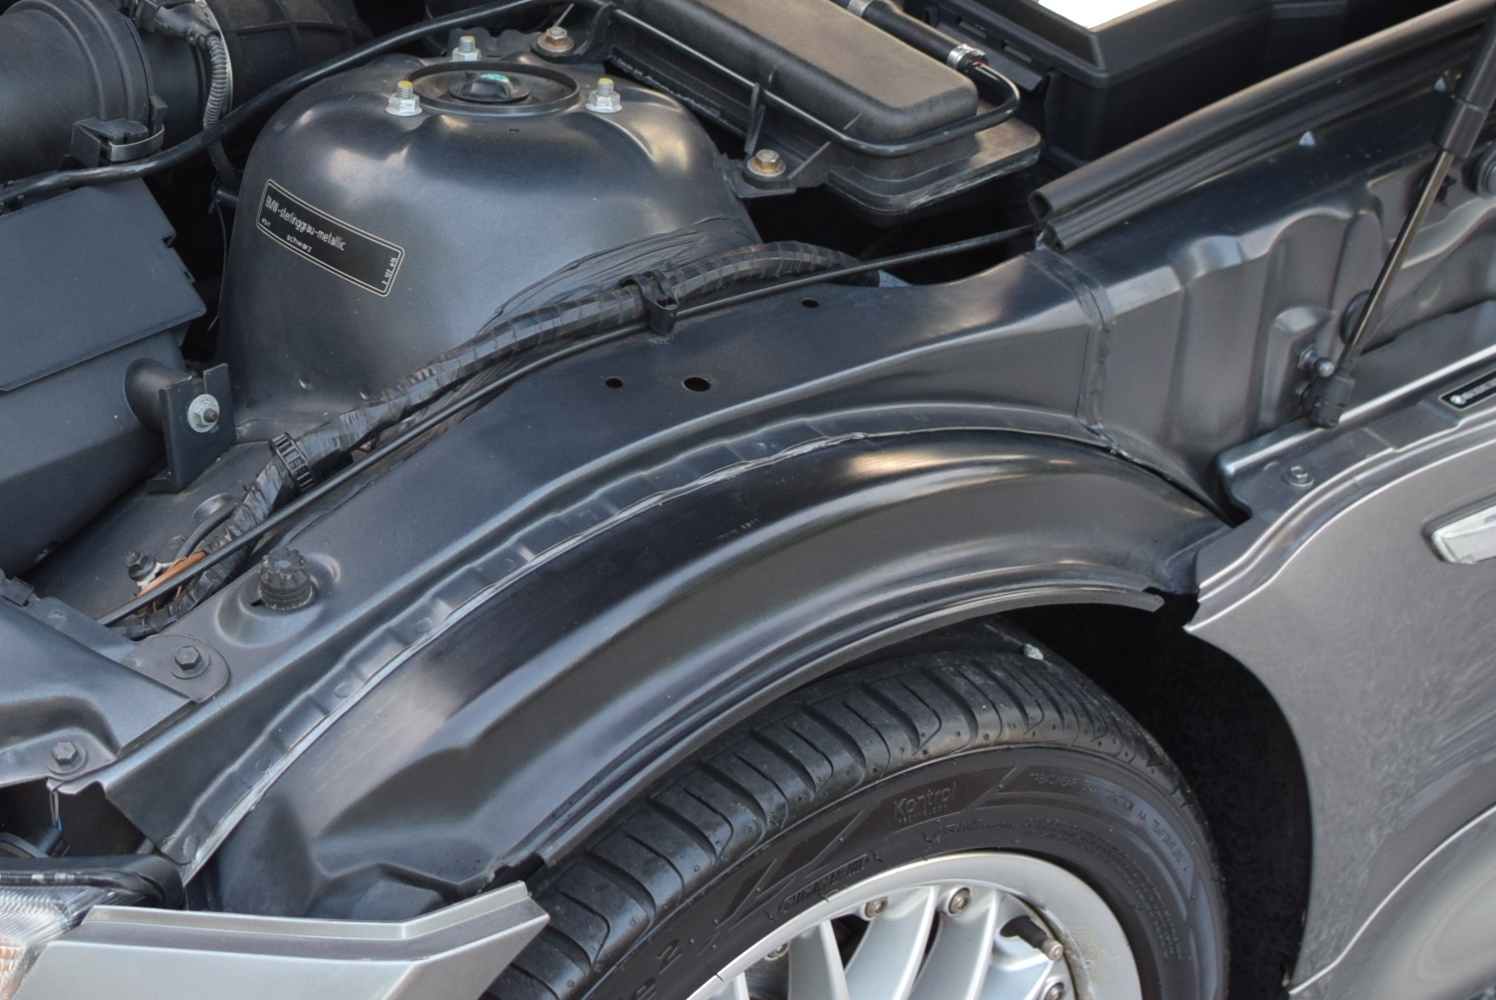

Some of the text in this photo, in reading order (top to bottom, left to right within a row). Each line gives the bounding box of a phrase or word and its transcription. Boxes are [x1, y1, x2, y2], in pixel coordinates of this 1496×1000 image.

[265, 194, 346, 251] BMW-sterlinggrau-metallic
[286, 234, 313, 253] schwarz
[893, 780, 957, 820] Kontrol
